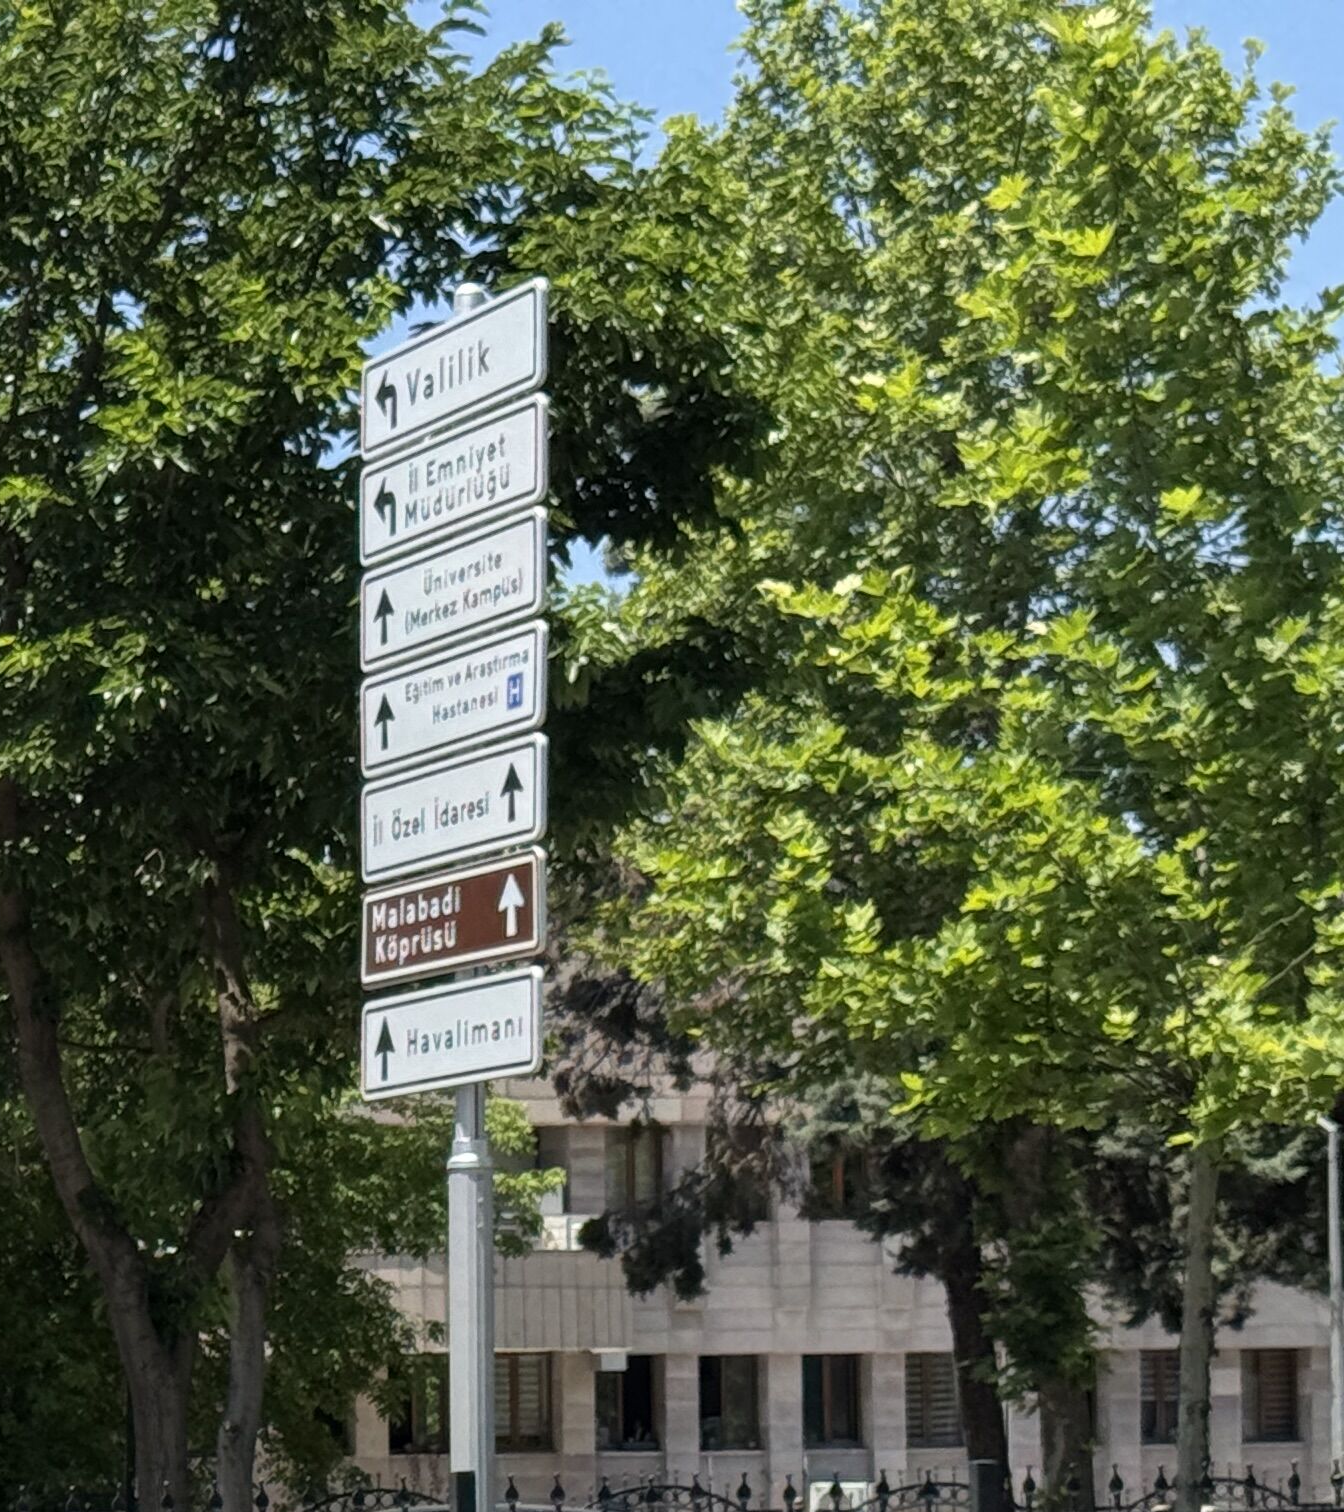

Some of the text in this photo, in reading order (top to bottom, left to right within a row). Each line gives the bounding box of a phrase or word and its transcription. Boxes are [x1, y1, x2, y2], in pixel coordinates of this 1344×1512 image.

[406, 339, 490, 406] Valilik
[408, 433, 506, 495] İl Emniyet
[404, 463, 511, 529] Müdürlüğü
[404, 567, 524, 635] (Merkez Kampüs)
[422, 552, 503, 597] Üniversite
[404, 648, 529, 705] Eğitim ve Araştırma
[432, 687, 499, 725] Hastanesi
[373, 790, 490, 848] İl Özel İdaresi
[371, 885, 461, 933] Malabadi
[374, 920, 457, 966] Köprüsü
[406, 1015, 524, 1058] Havalimanı
